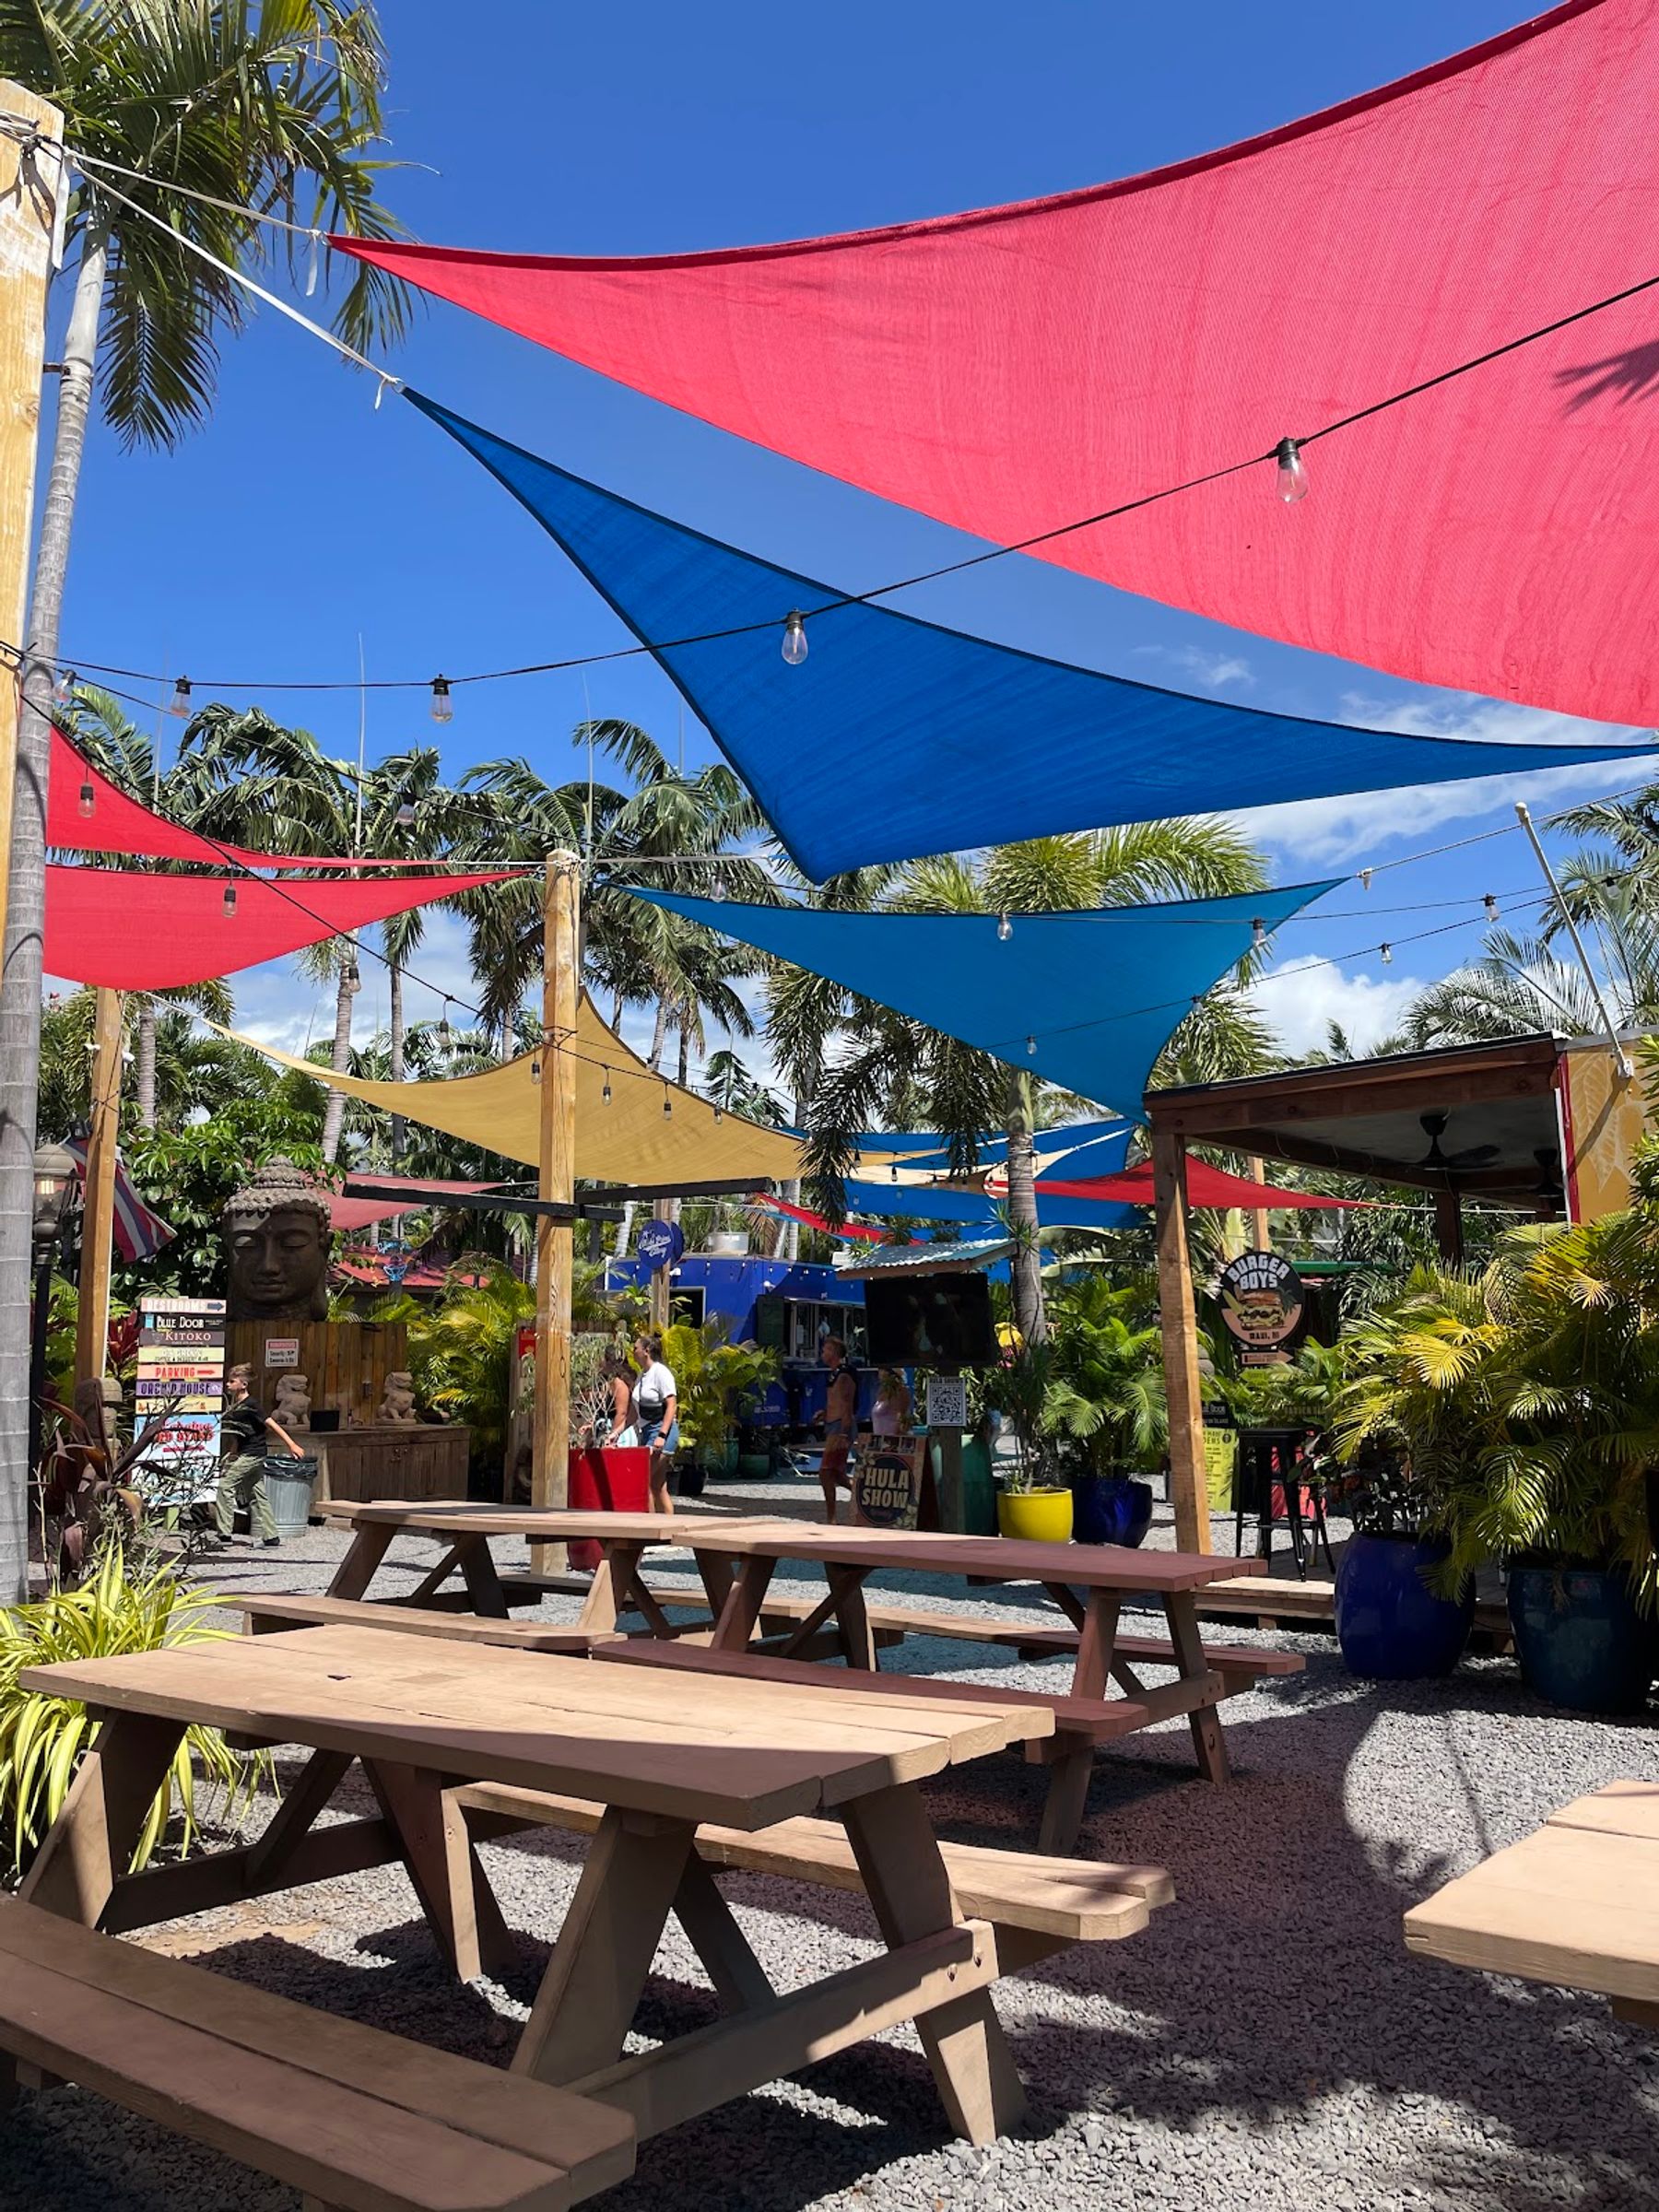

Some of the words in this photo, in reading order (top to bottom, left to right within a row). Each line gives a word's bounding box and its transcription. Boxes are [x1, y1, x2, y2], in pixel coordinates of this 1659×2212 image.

[1227, 1254, 1289, 1282] BURGER
[1240, 1272, 1278, 1289] BOYS
[147, 1300, 206, 1311] RESTROOMS
[166, 1332, 212, 1341] KITOKO
[156, 1367, 195, 1378] PARKING
[180, 1383, 211, 1394] HOUSE
[865, 1467, 909, 1489] HULA
[862, 1488, 909, 1509] SHOW
